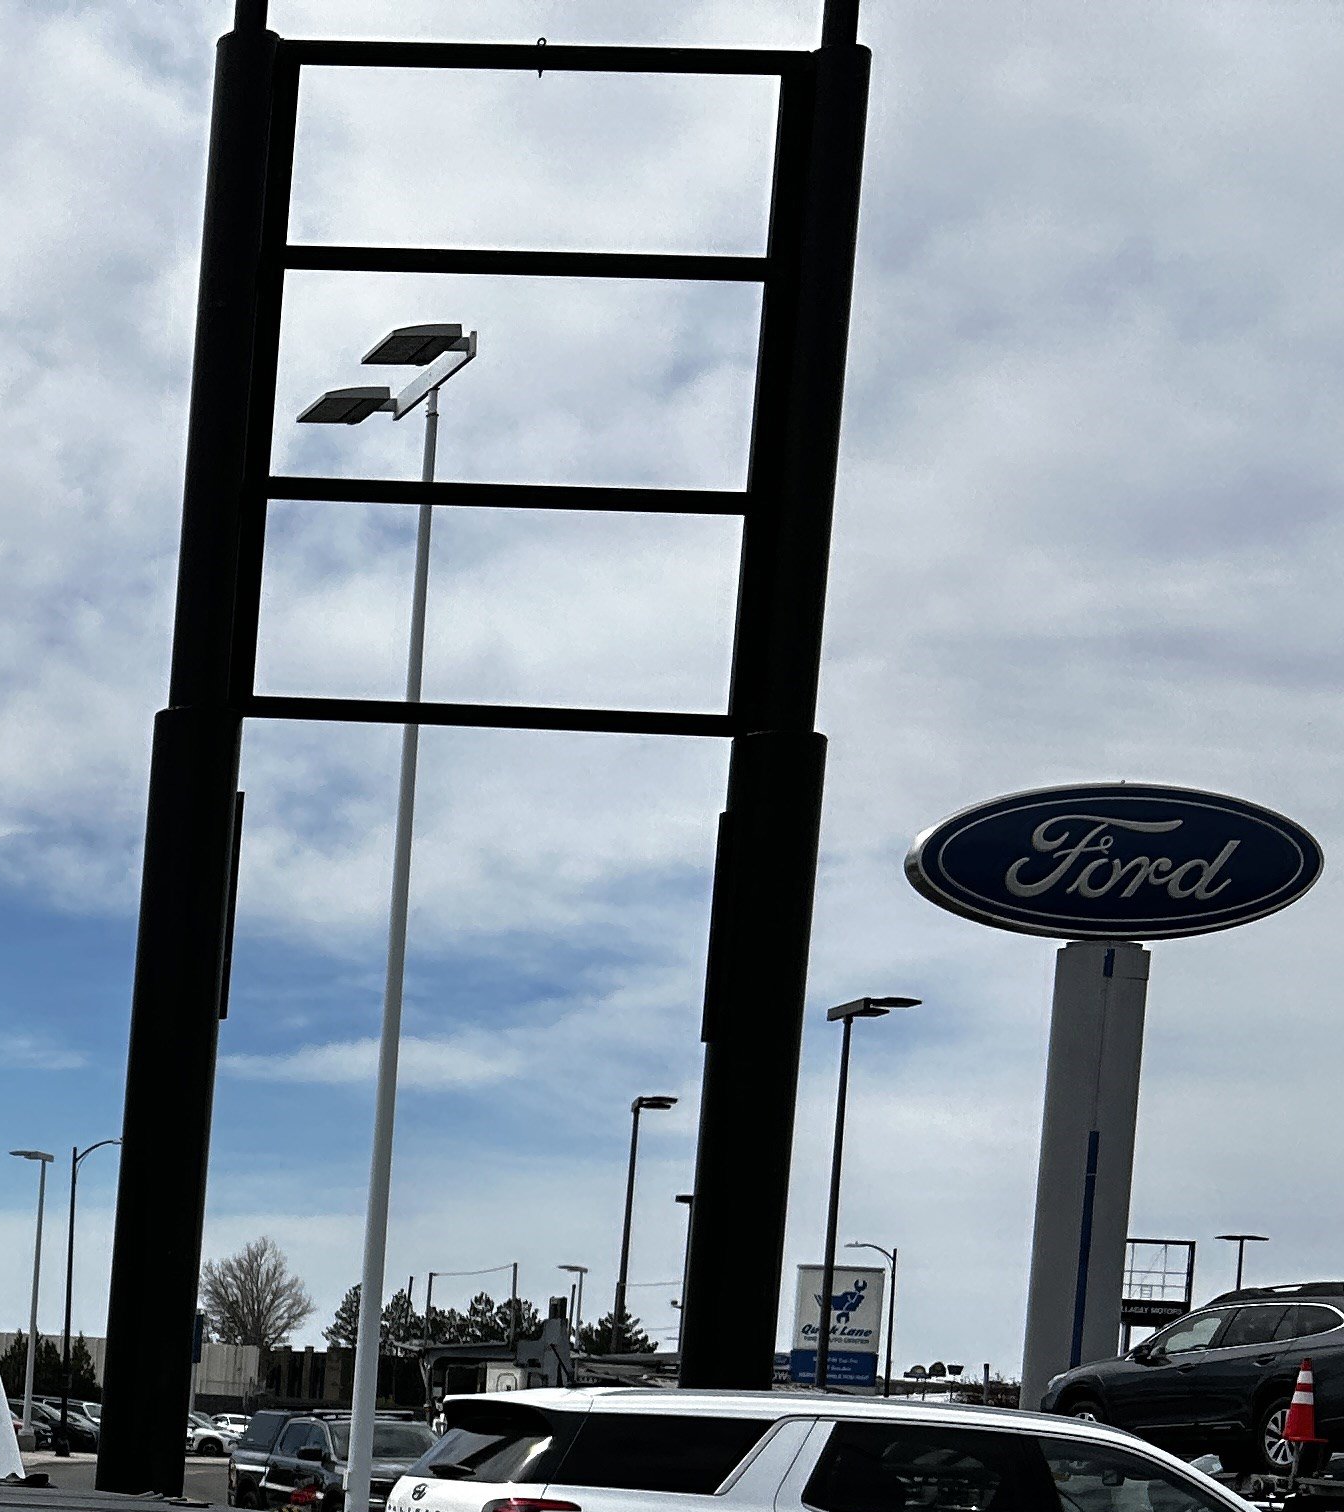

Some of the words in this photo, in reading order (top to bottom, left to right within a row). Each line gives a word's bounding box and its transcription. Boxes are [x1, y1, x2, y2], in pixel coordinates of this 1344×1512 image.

[1005, 814, 1242, 900] Ford
[801, 1324, 839, 1336] Quk
[840, 1326, 873, 1338] Lane
